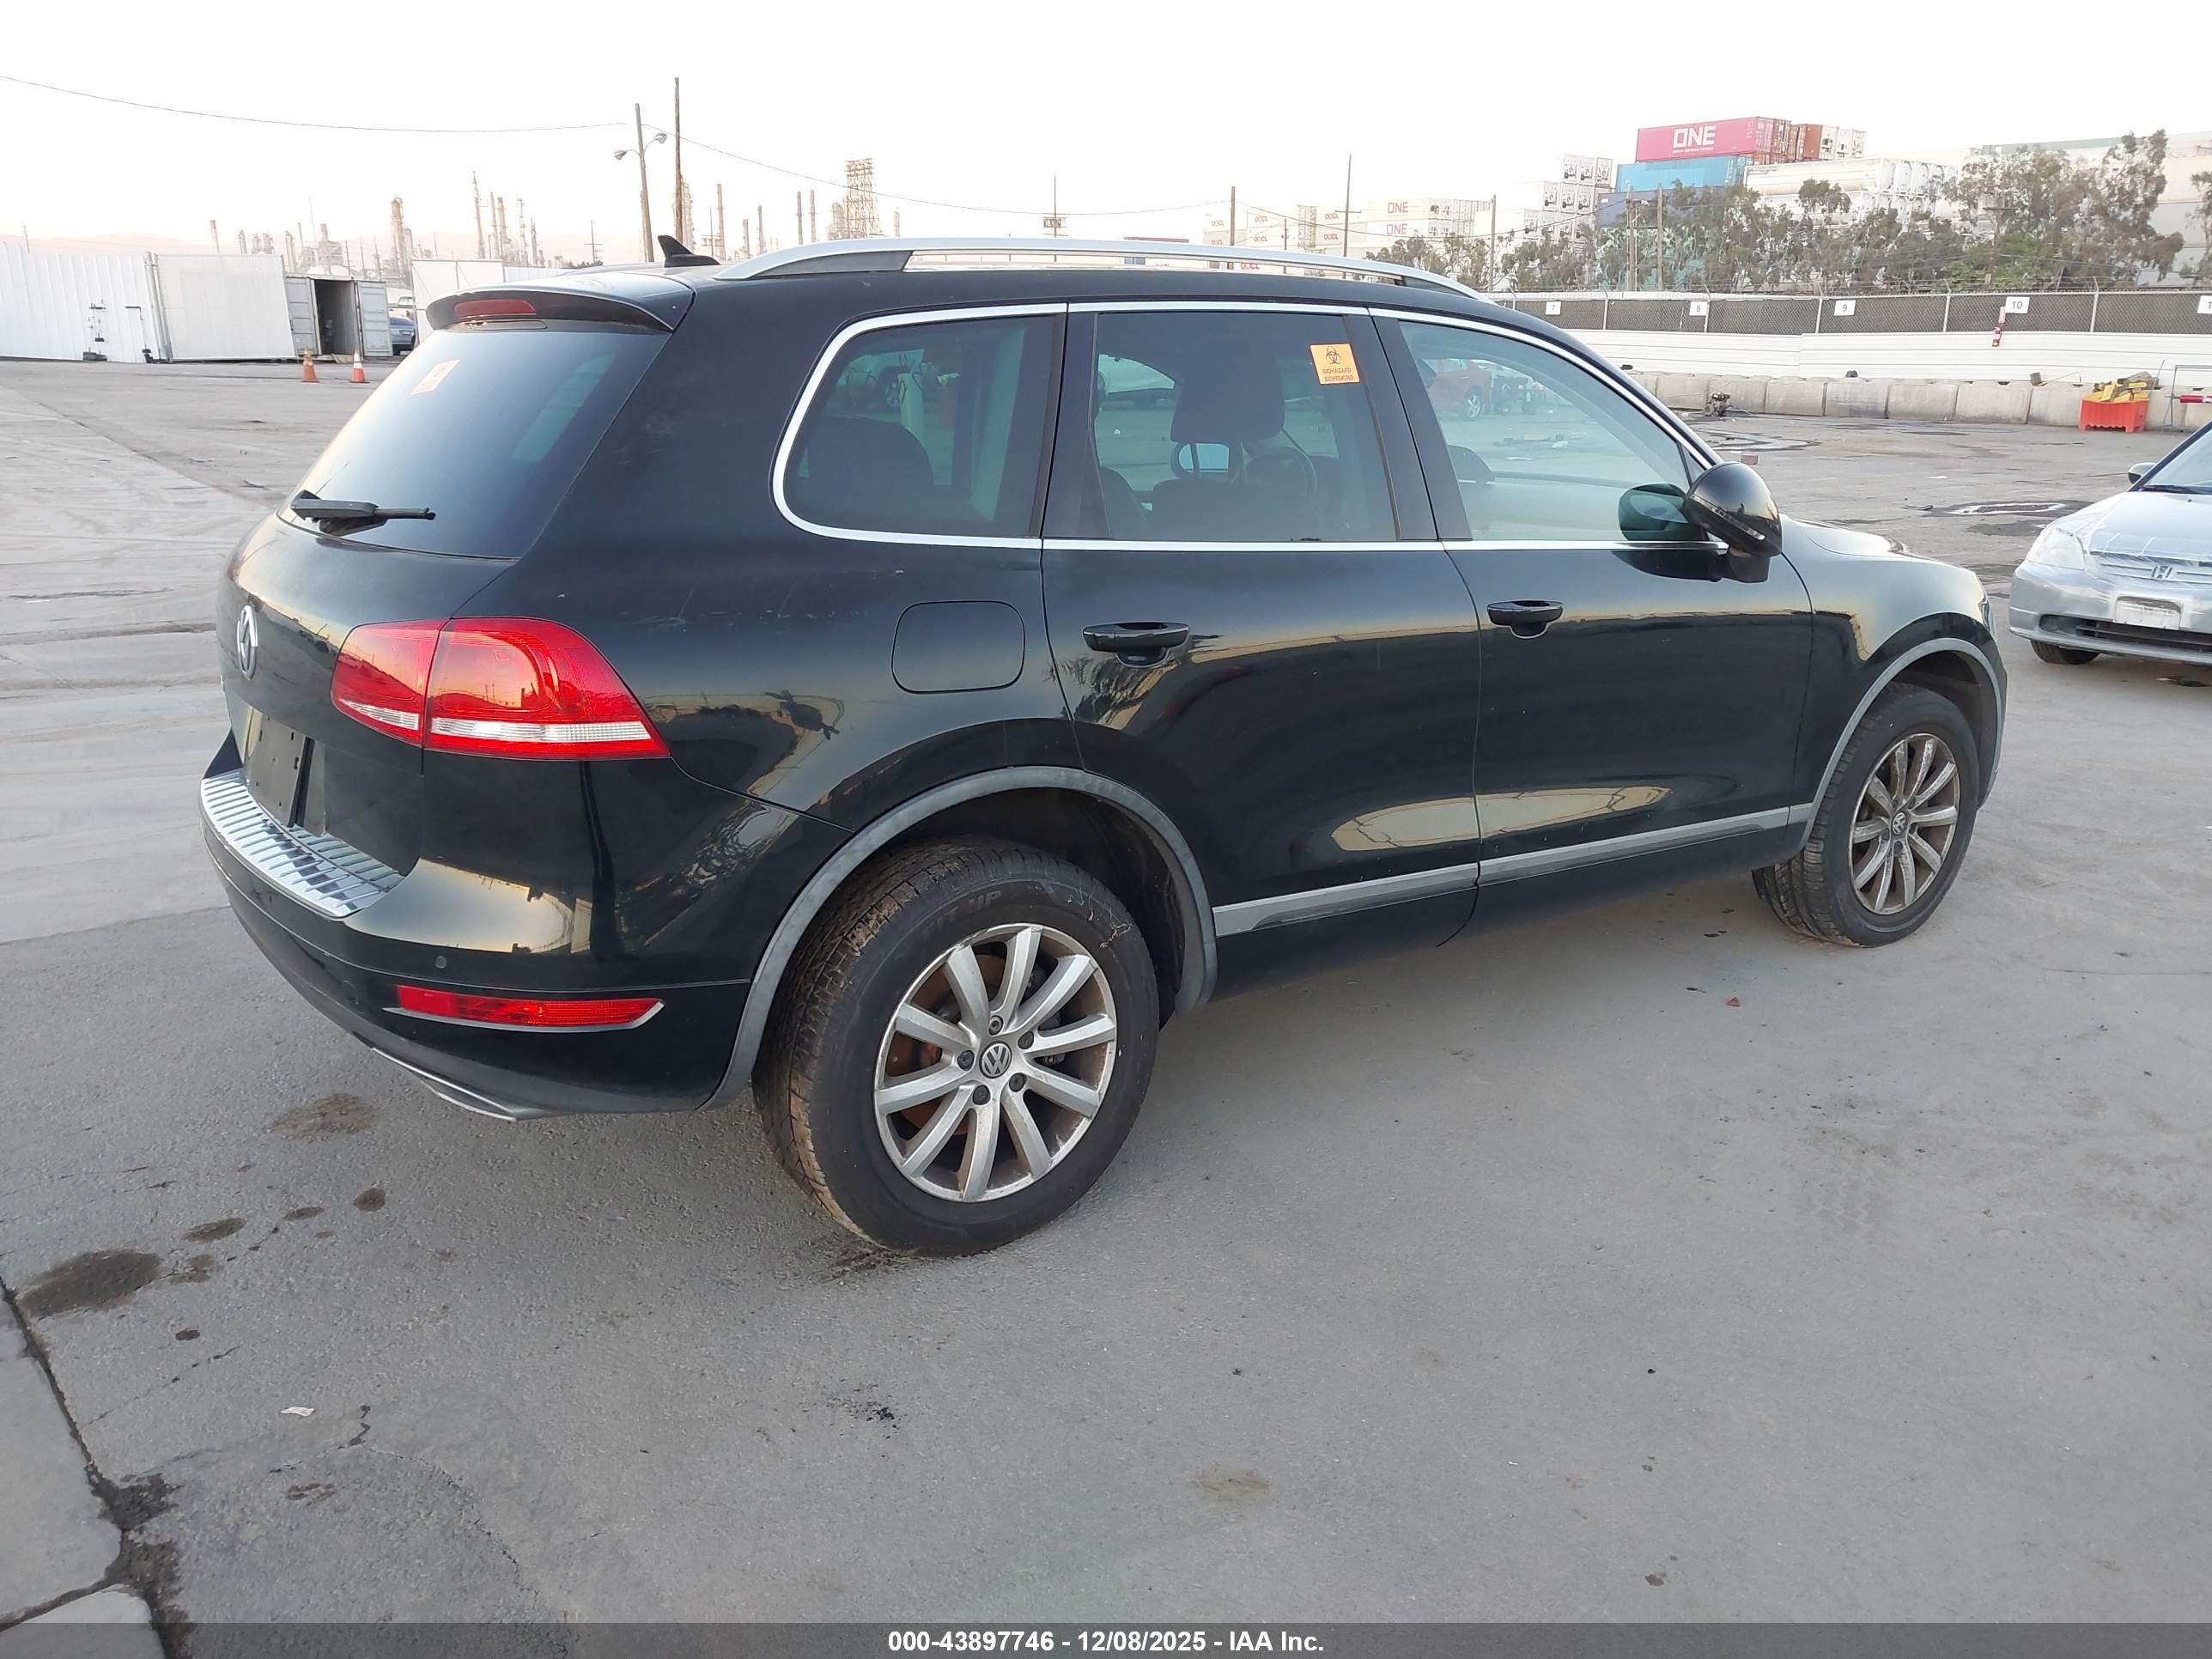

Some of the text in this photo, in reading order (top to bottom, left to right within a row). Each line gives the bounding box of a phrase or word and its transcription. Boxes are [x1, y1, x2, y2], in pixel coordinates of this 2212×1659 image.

[1673, 125, 1717, 149] ONE
[1388, 202, 1409, 214] ONE
[1386, 223, 1408, 234] ONE
[1842, 303, 1848, 313] 9
[2011, 301, 2023, 310] 10
